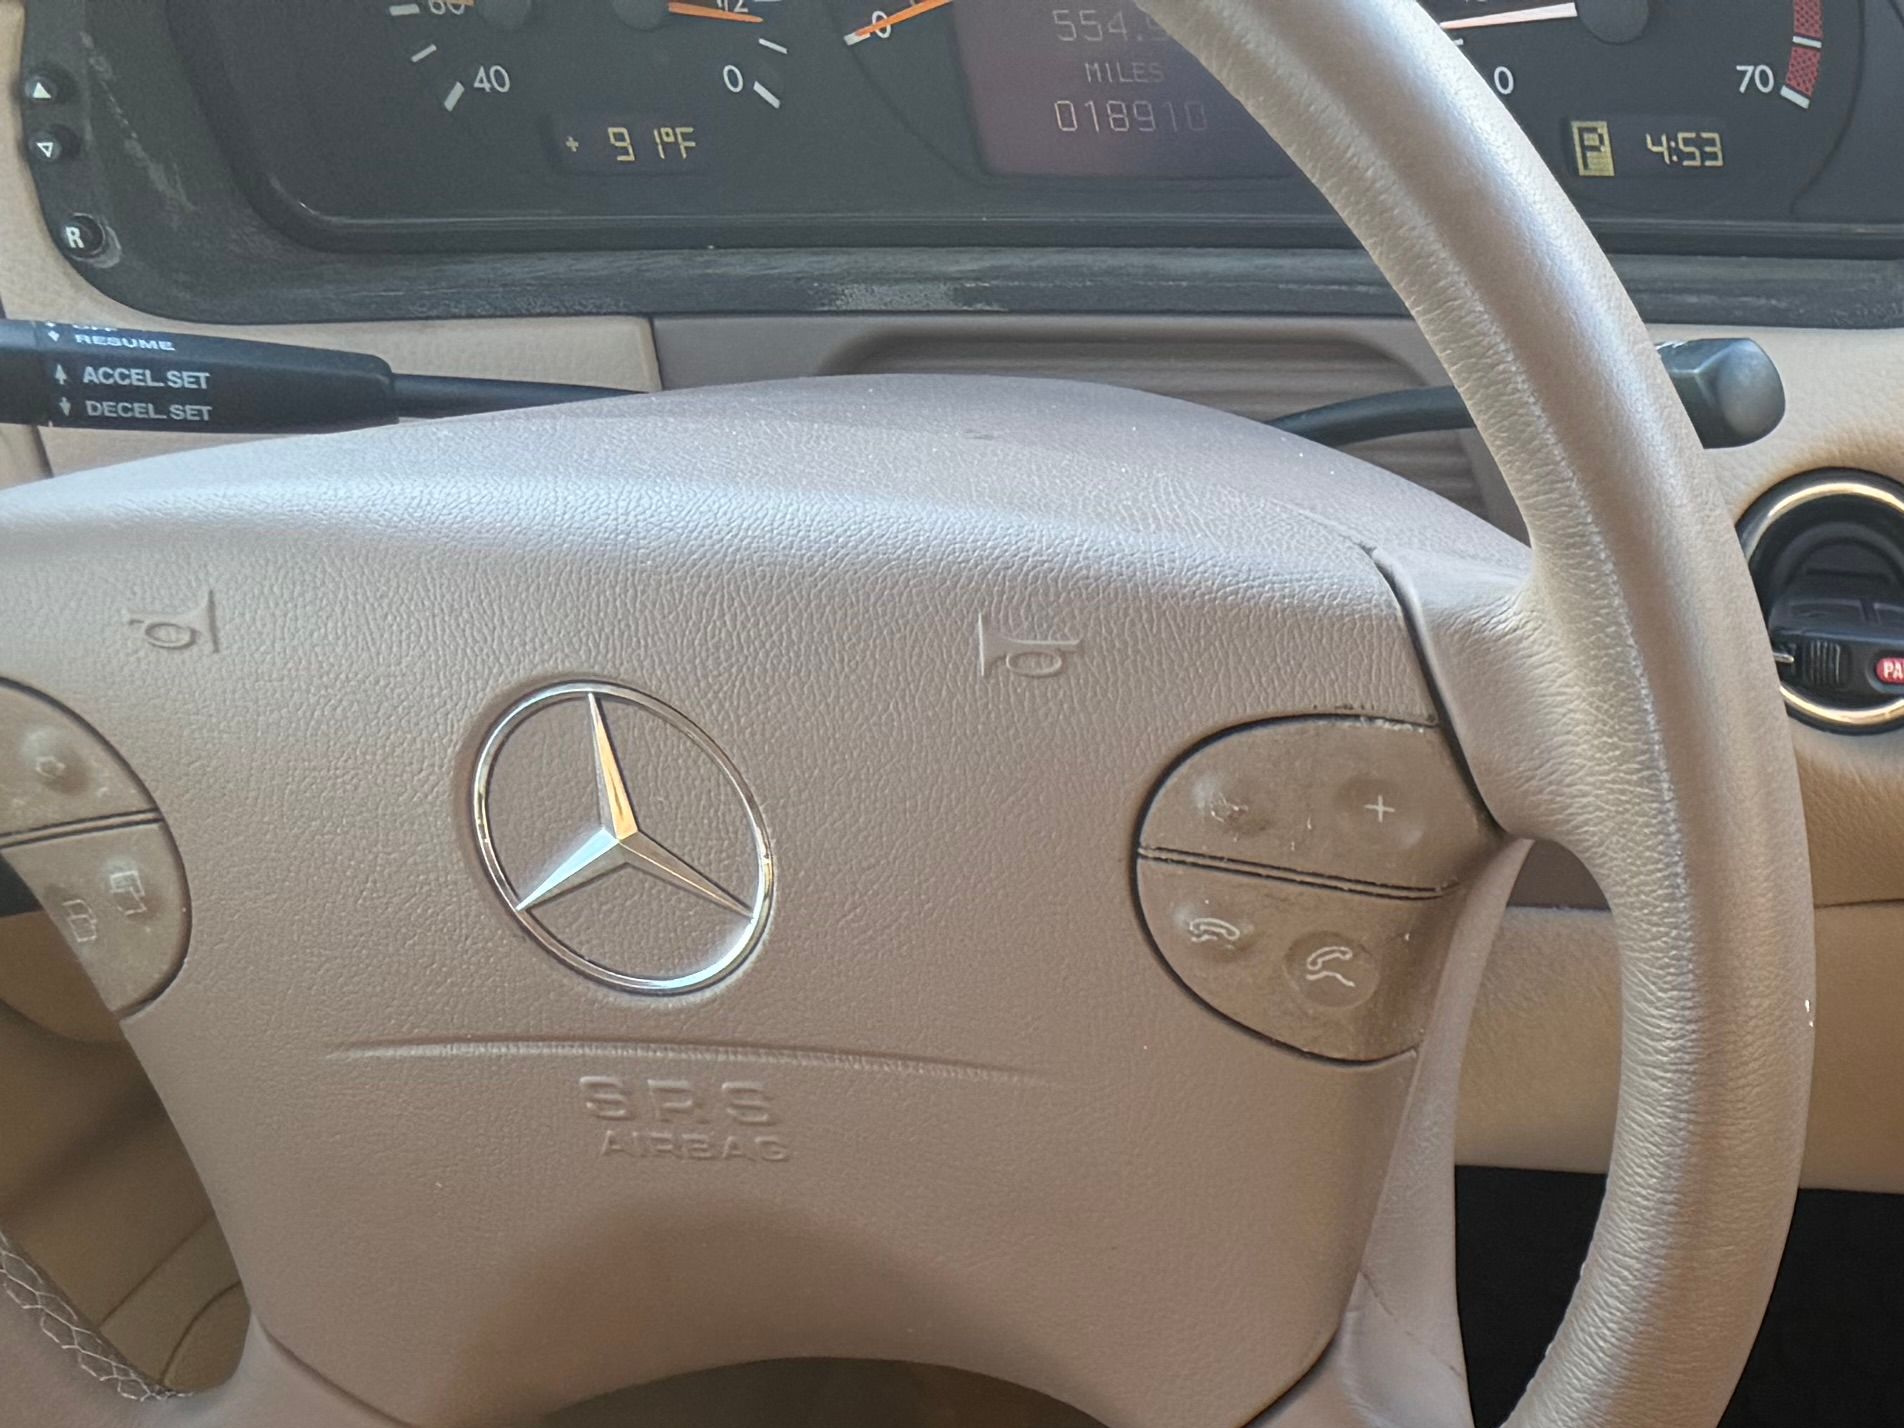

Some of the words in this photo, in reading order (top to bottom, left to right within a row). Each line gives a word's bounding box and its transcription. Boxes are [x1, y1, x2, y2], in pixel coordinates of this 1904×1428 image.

[473, 65, 511, 93] 40
[722, 64, 744, 93] 0
[1084, 61, 1165, 83] MILES
[1493, 66, 1515, 95] 0
[1736, 64, 1775, 94] 70
[1645, 131, 1725, 167] 4:53
[65, 226, 85, 249] R
[74, 334, 176, 351] RESUME
[83, 365, 165, 387] ACCEL
[166, 370, 211, 390] SET
[85, 400, 168, 420] DECEL
[169, 405, 213, 421] SET
[600, 1129, 793, 1163] AIRBAG
